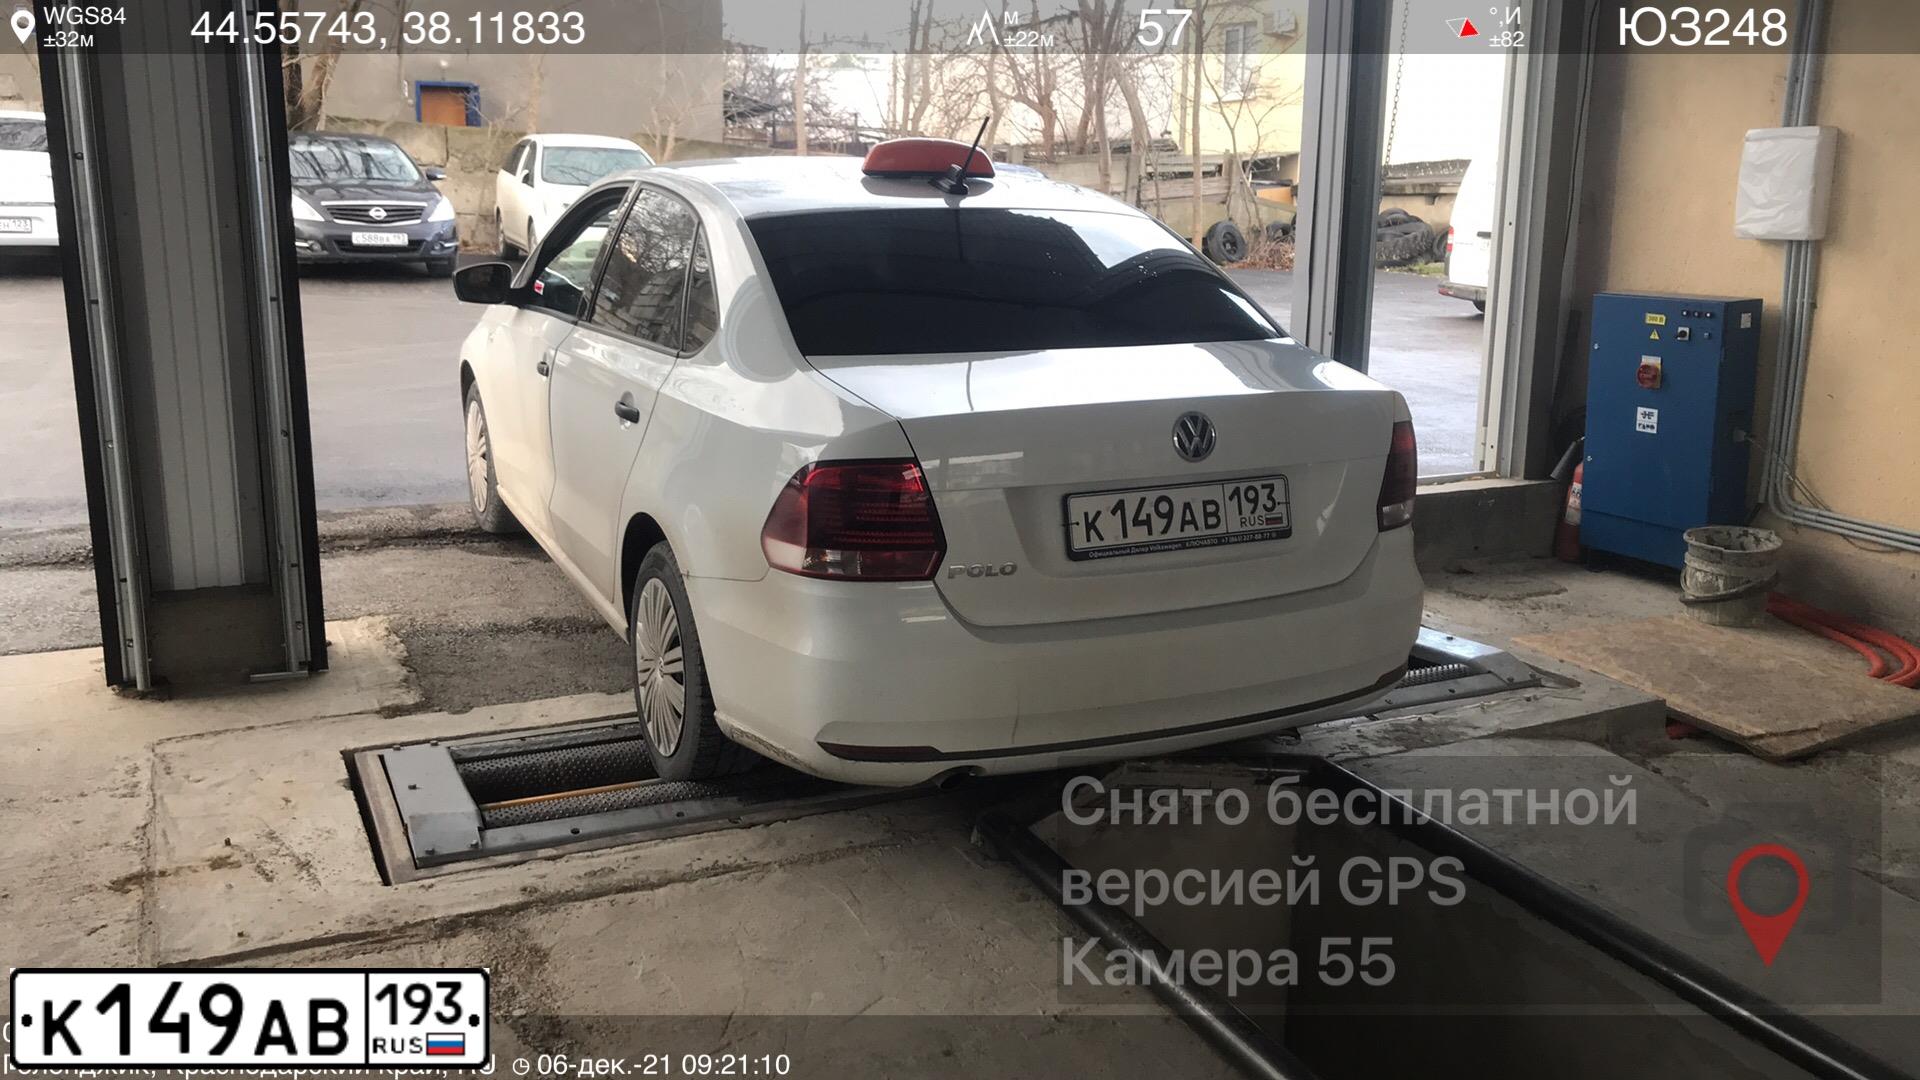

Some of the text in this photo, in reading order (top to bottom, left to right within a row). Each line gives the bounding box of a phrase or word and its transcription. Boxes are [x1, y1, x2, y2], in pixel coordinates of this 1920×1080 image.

[1083, 483, 1277, 543] К149АВ 193
[1240, 515, 1265, 528] RUS
[948, 561, 1018, 579] POLO
